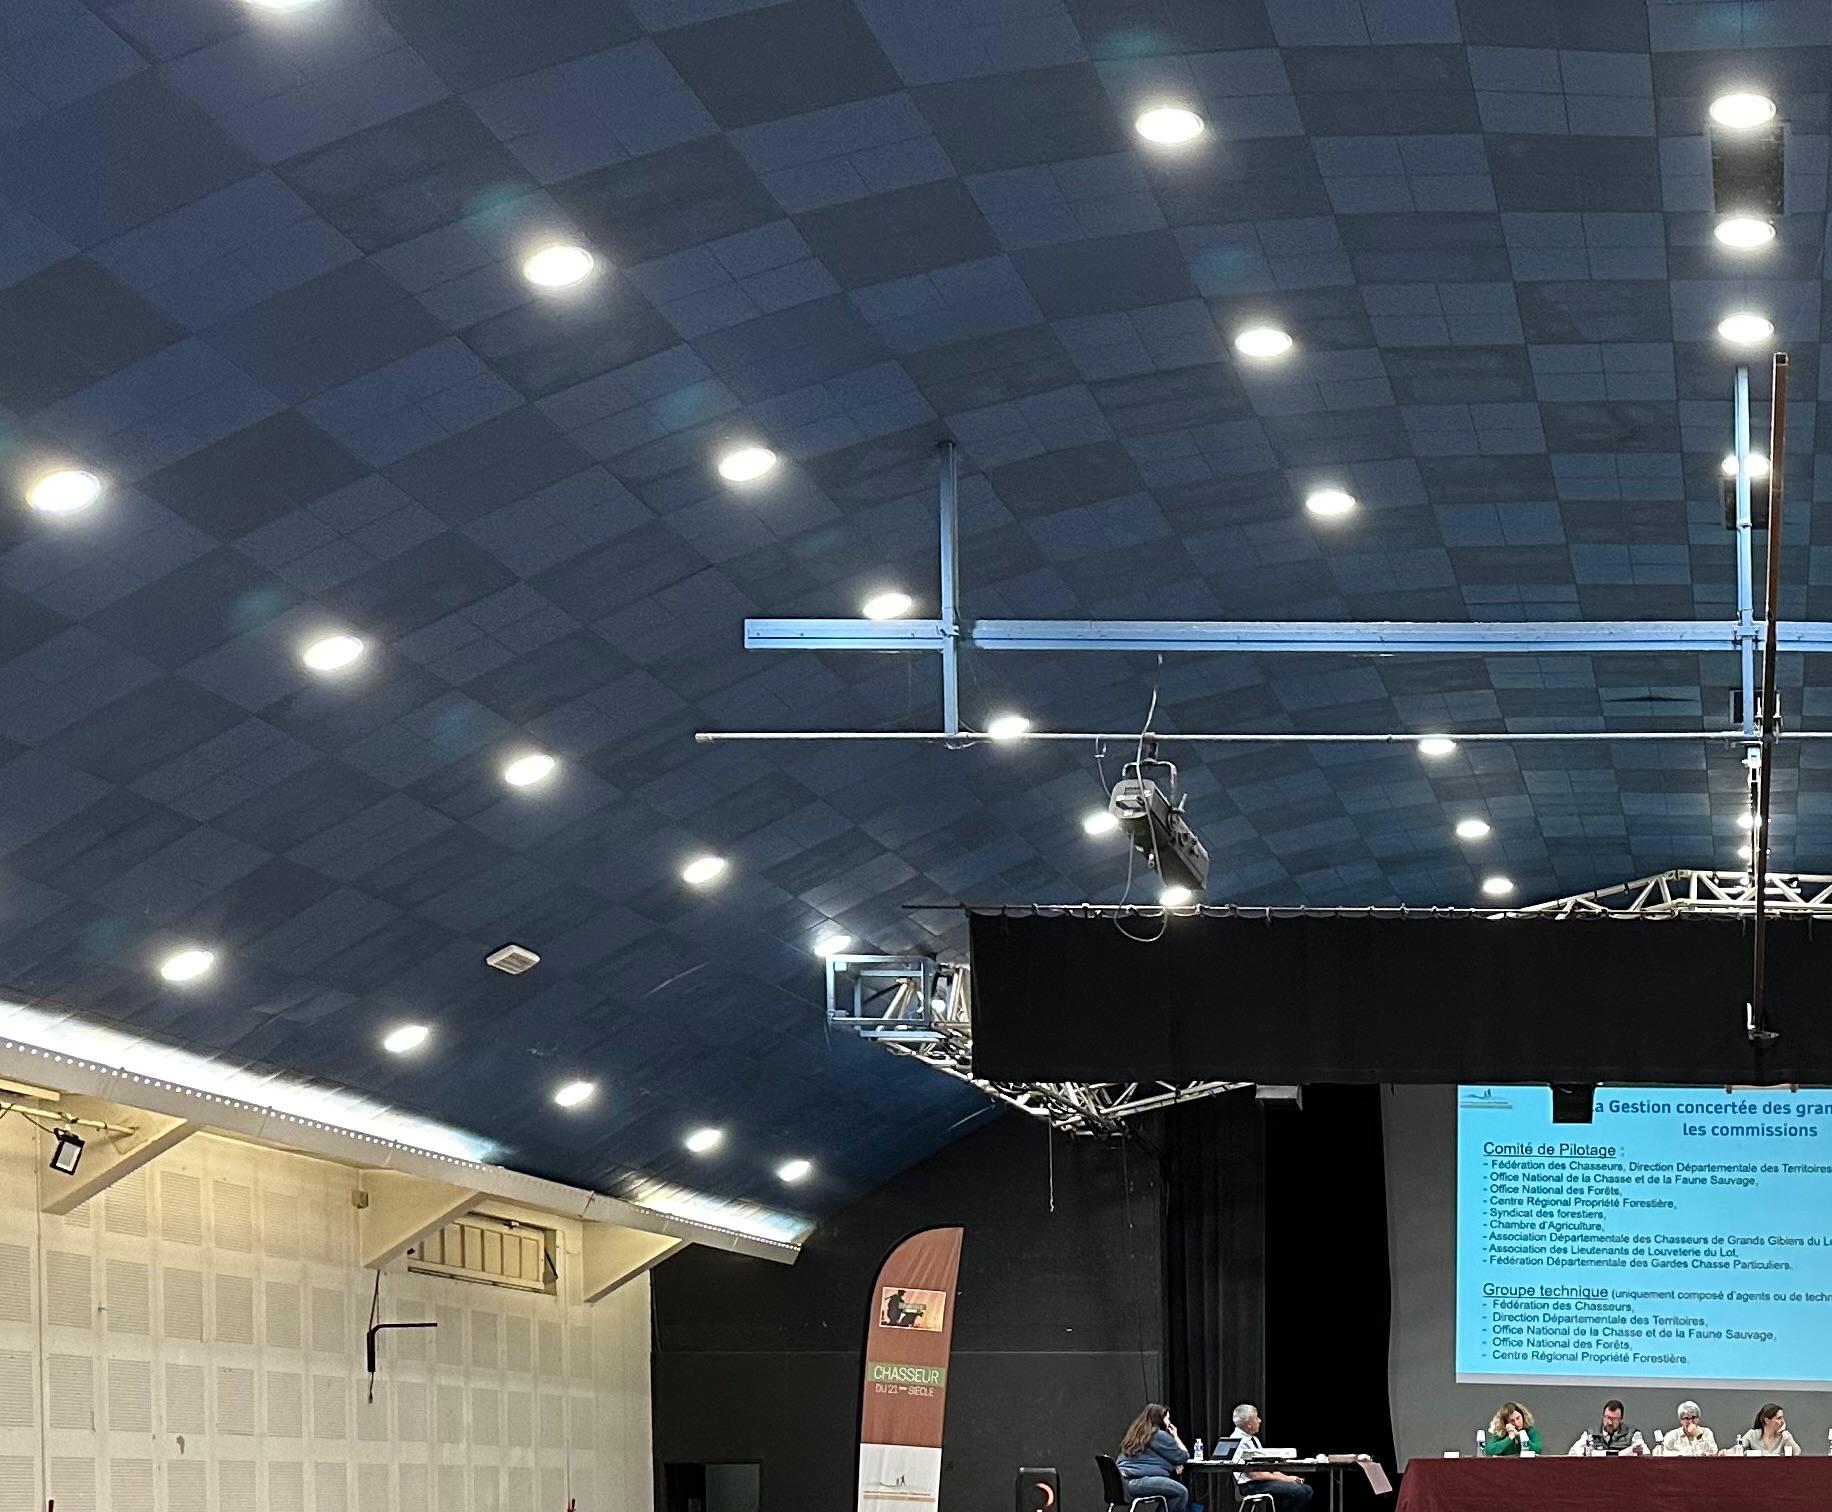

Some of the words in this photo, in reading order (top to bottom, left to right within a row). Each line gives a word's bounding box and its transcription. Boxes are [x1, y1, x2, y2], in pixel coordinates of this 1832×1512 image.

[1609, 1100, 1671, 1113] Gestion
[1676, 1099, 1758, 1114] concertée
[1762, 1101, 1791, 1114] des
[1683, 1122, 1706, 1136] les
[1711, 1123, 1817, 1137] commissions
[1484, 1142, 1533, 1156] Comité
[1537, 1143, 1555, 1156] de
[1560, 1143, 1616, 1158] Pilotage
[1492, 1160, 1545, 1170] Fédération
[1548, 1160, 1566, 1170] des
[1629, 1162, 1673, 1172] Direction
[1677, 1162, 1757, 1174] Départementale
[1760, 1163, 1779, 1173] des
[1490, 1172, 1519, 1182] Office
[1522, 1173, 1563, 1183] National
[1566, 1173, 1579, 1183] de
[1582, 1173, 1591, 1183] la
[1594, 1174, 1632, 1183] Chasse
[1635, 1174, 1645, 1184] et
[1647, 1175, 1660, 1184] de
[1663, 1175, 1672, 1184] la
[1675, 1175, 1707, 1184] Faune
[1490, 1184, 1519, 1194] Office
[1522, 1185, 1563, 1195] National
[1566, 1185, 1584, 1195] des
[1490, 1196, 1524, 1206] Centre
[1527, 1196, 1571, 1208] Régional
[1574, 1197, 1620, 1208] Propriété
[1490, 1208, 1533, 1220] Syndicat
[1536, 1209, 1554, 1218] des
[1490, 1219, 1536, 1229] Chambre
[1489, 1231, 1547, 1241] Association
[1550, 1232, 1630, 1244] Départementale
[1633, 1234, 1651, 1243] des
[1654, 1234, 1708, 1244] Chasseurs
[1711, 1236, 1724, 1245] de
[1727, 1235, 1765, 1245] Grands
[1768, 1236, 1804, 1245] Gibiers
[1807, 1236, 1820, 1246] du
[1489, 1244, 1547, 1254] Association
[1550, 1245, 1568, 1255] des
[1571, 1245, 1629, 1255] Lieutenants
[1632, 1246, 1645, 1256] de
[1648, 1247, 1701, 1256] Louveterie
[1703, 1248, 1717, 1257] du
[1490, 1255, 1543, 1265] Fédération
[1547, 1256, 1627, 1268] Départementale
[1629, 1258, 1648, 1267] des
[1651, 1259, 1688, 1268] Gardes
[1691, 1259, 1730, 1269] Chasse
[1483, 1283, 1535, 1298] Groupe
[1540, 1284, 1608, 1299] technique
[1678, 1291, 1724, 1302] composé
[1789, 1292, 1802, 1301] de
[1493, 1299, 1549, 1309] Fédération
[1552, 1301, 1572, 1310] des
[1493, 1312, 1539, 1322] Direction
[1543, 1313, 1627, 1325] Départementale
[1630, 1315, 1649, 1325] des
[1493, 1325, 1523, 1334] Office
[1527, 1325, 1570, 1335] National
[1573, 1326, 1586, 1336] de
[1590, 1327, 1599, 1336] la
[1602, 1327, 1642, 1337] Chasse
[1646, 1329, 1656, 1337] et
[1659, 1328, 1672, 1338] de
[1676, 1328, 1685, 1338] la
[1689, 1329, 1722, 1339] Faune
[1493, 1337, 1523, 1347] Office
[1527, 1338, 1570, 1348] National
[1573, 1339, 1592, 1349] des
[1493, 1350, 1528, 1360] Centre
[1531, 1351, 1578, 1363] Régional
[1581, 1352, 1629, 1364] Propriété
[874, 1366, 939, 1384] CHASSEUR
